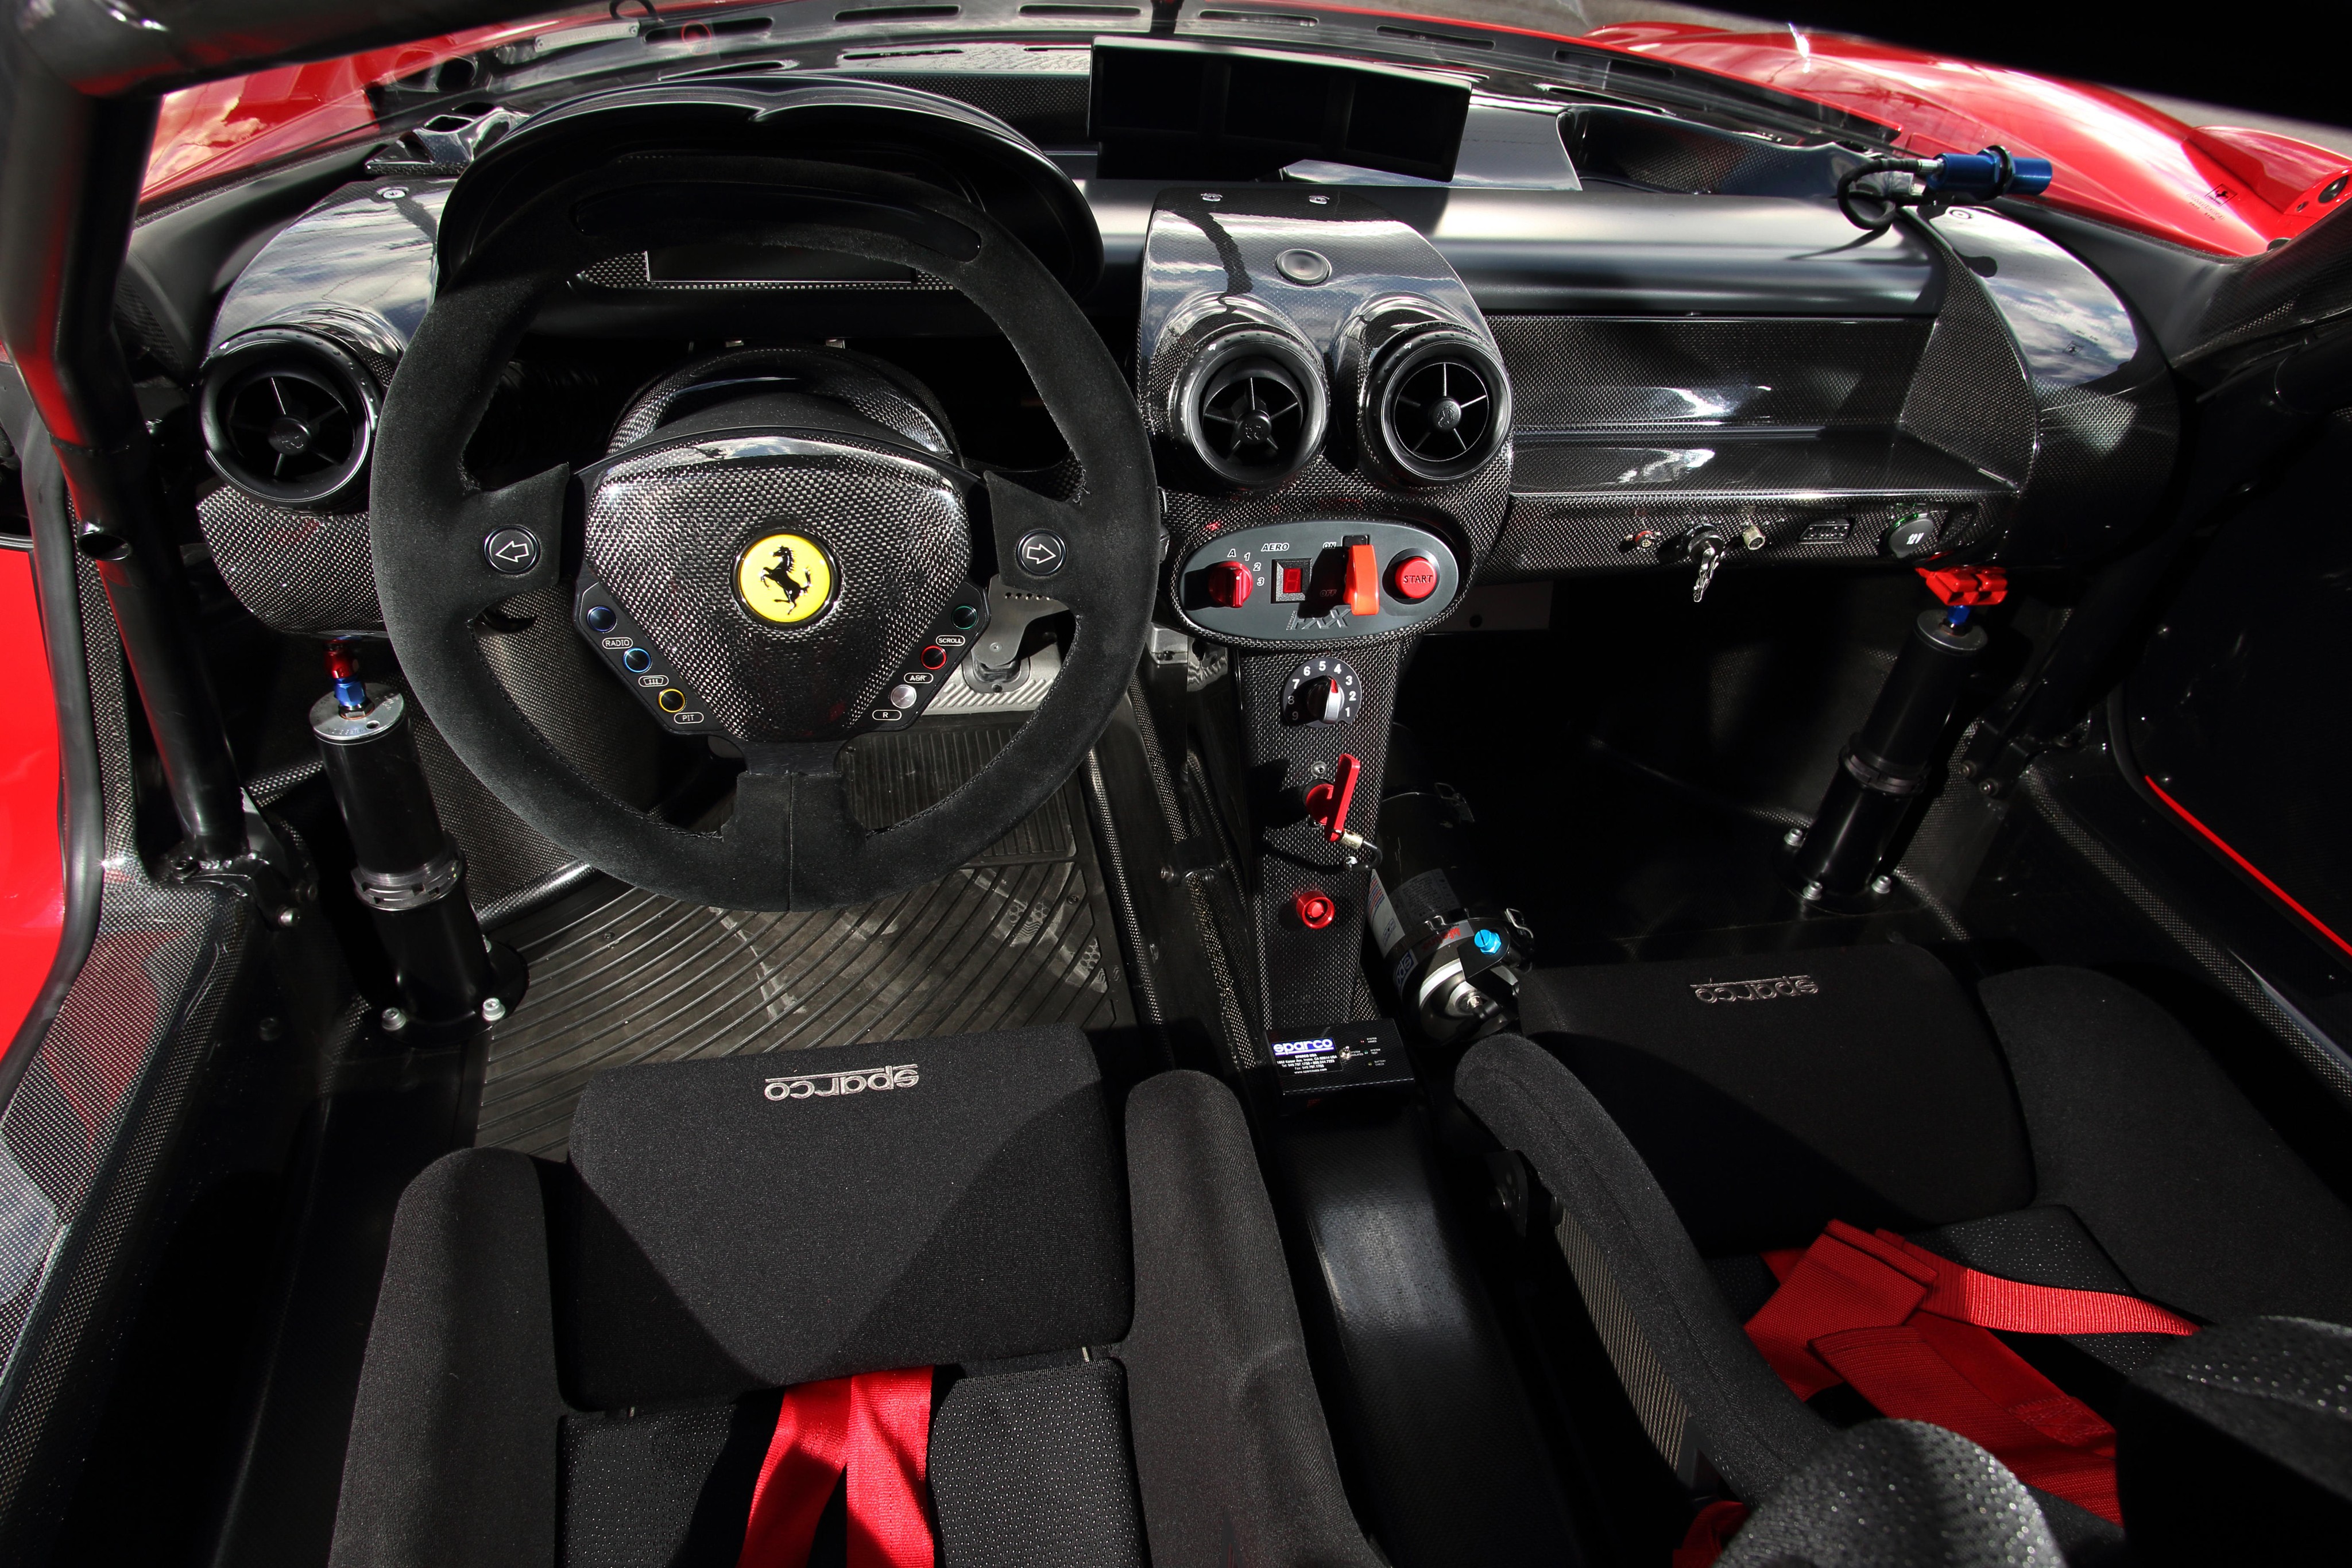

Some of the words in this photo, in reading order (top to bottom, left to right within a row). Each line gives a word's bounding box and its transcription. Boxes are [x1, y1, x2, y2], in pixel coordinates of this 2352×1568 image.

[1906, 532, 1924, 545] 12V
[1260, 543, 1290, 552] AERO
[1322, 541, 1337, 549] ON
[1227, 548, 1236, 557] A
[1244, 552, 1251, 562] 1
[1253, 562, 1262, 571] 2
[1256, 577, 1265, 586] 3
[1403, 575, 1433, 584] START
[1320, 589, 1337, 597] OFF
[1303, 666, 1311, 676] 6
[1318, 661, 1326, 671] 5
[1334, 664, 1342, 674] 4
[1292, 679, 1300, 689] 7
[1345, 675, 1353, 686] 3
[1287, 695, 1294, 704] 8
[1349, 691, 1356, 701] 2
[1292, 711, 1299, 721] 9
[1345, 707, 1350, 717] 1
[1695, 976, 1819, 1003] sparco
[1274, 1039, 1333, 1055] sparco
[764, 1065, 919, 1101] sparco
